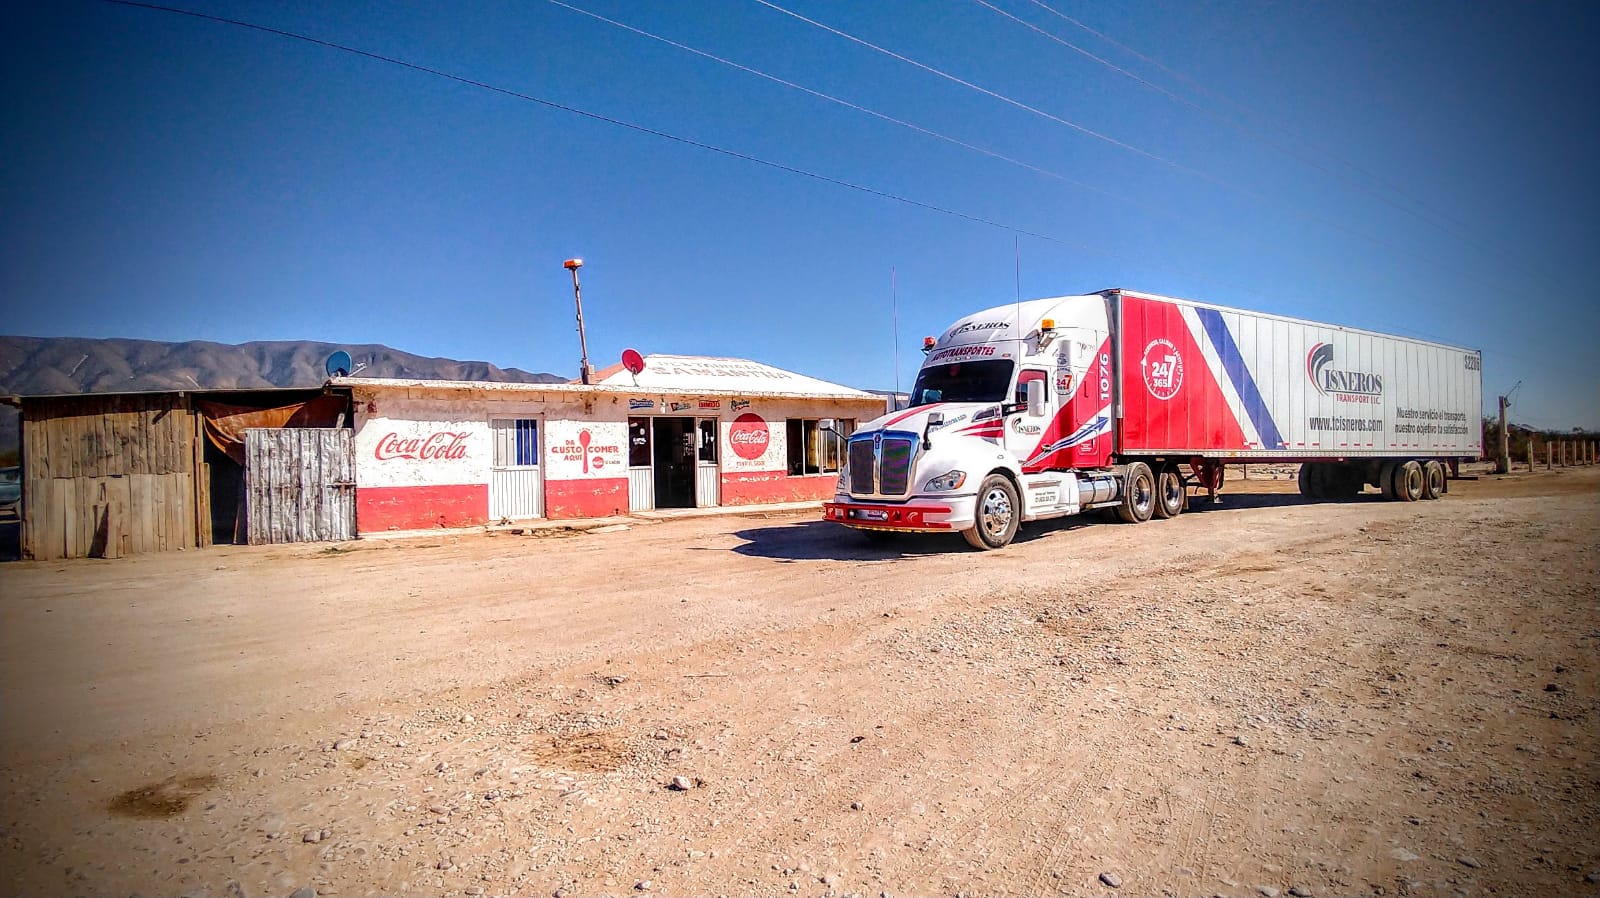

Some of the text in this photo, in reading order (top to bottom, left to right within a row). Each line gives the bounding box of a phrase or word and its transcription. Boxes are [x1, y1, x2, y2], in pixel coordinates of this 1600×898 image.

[1100, 353, 1109, 401] 1076
[1153, 378, 1168, 388] 365
[1336, 393, 1369, 404] TRANSPORT
[1396, 406, 1418, 419] Nuestro
[1419, 409, 1438, 420] servicio
[1309, 415, 1383, 432] www.tcisneros.com
[1395, 422, 1416, 433] nuestro
[1416, 422, 1437, 436] objetivo
[731, 429, 767, 444] Coca-Cola
[374, 431, 473, 461] Coca-Cola
[551, 446, 582, 454] GUSTO
